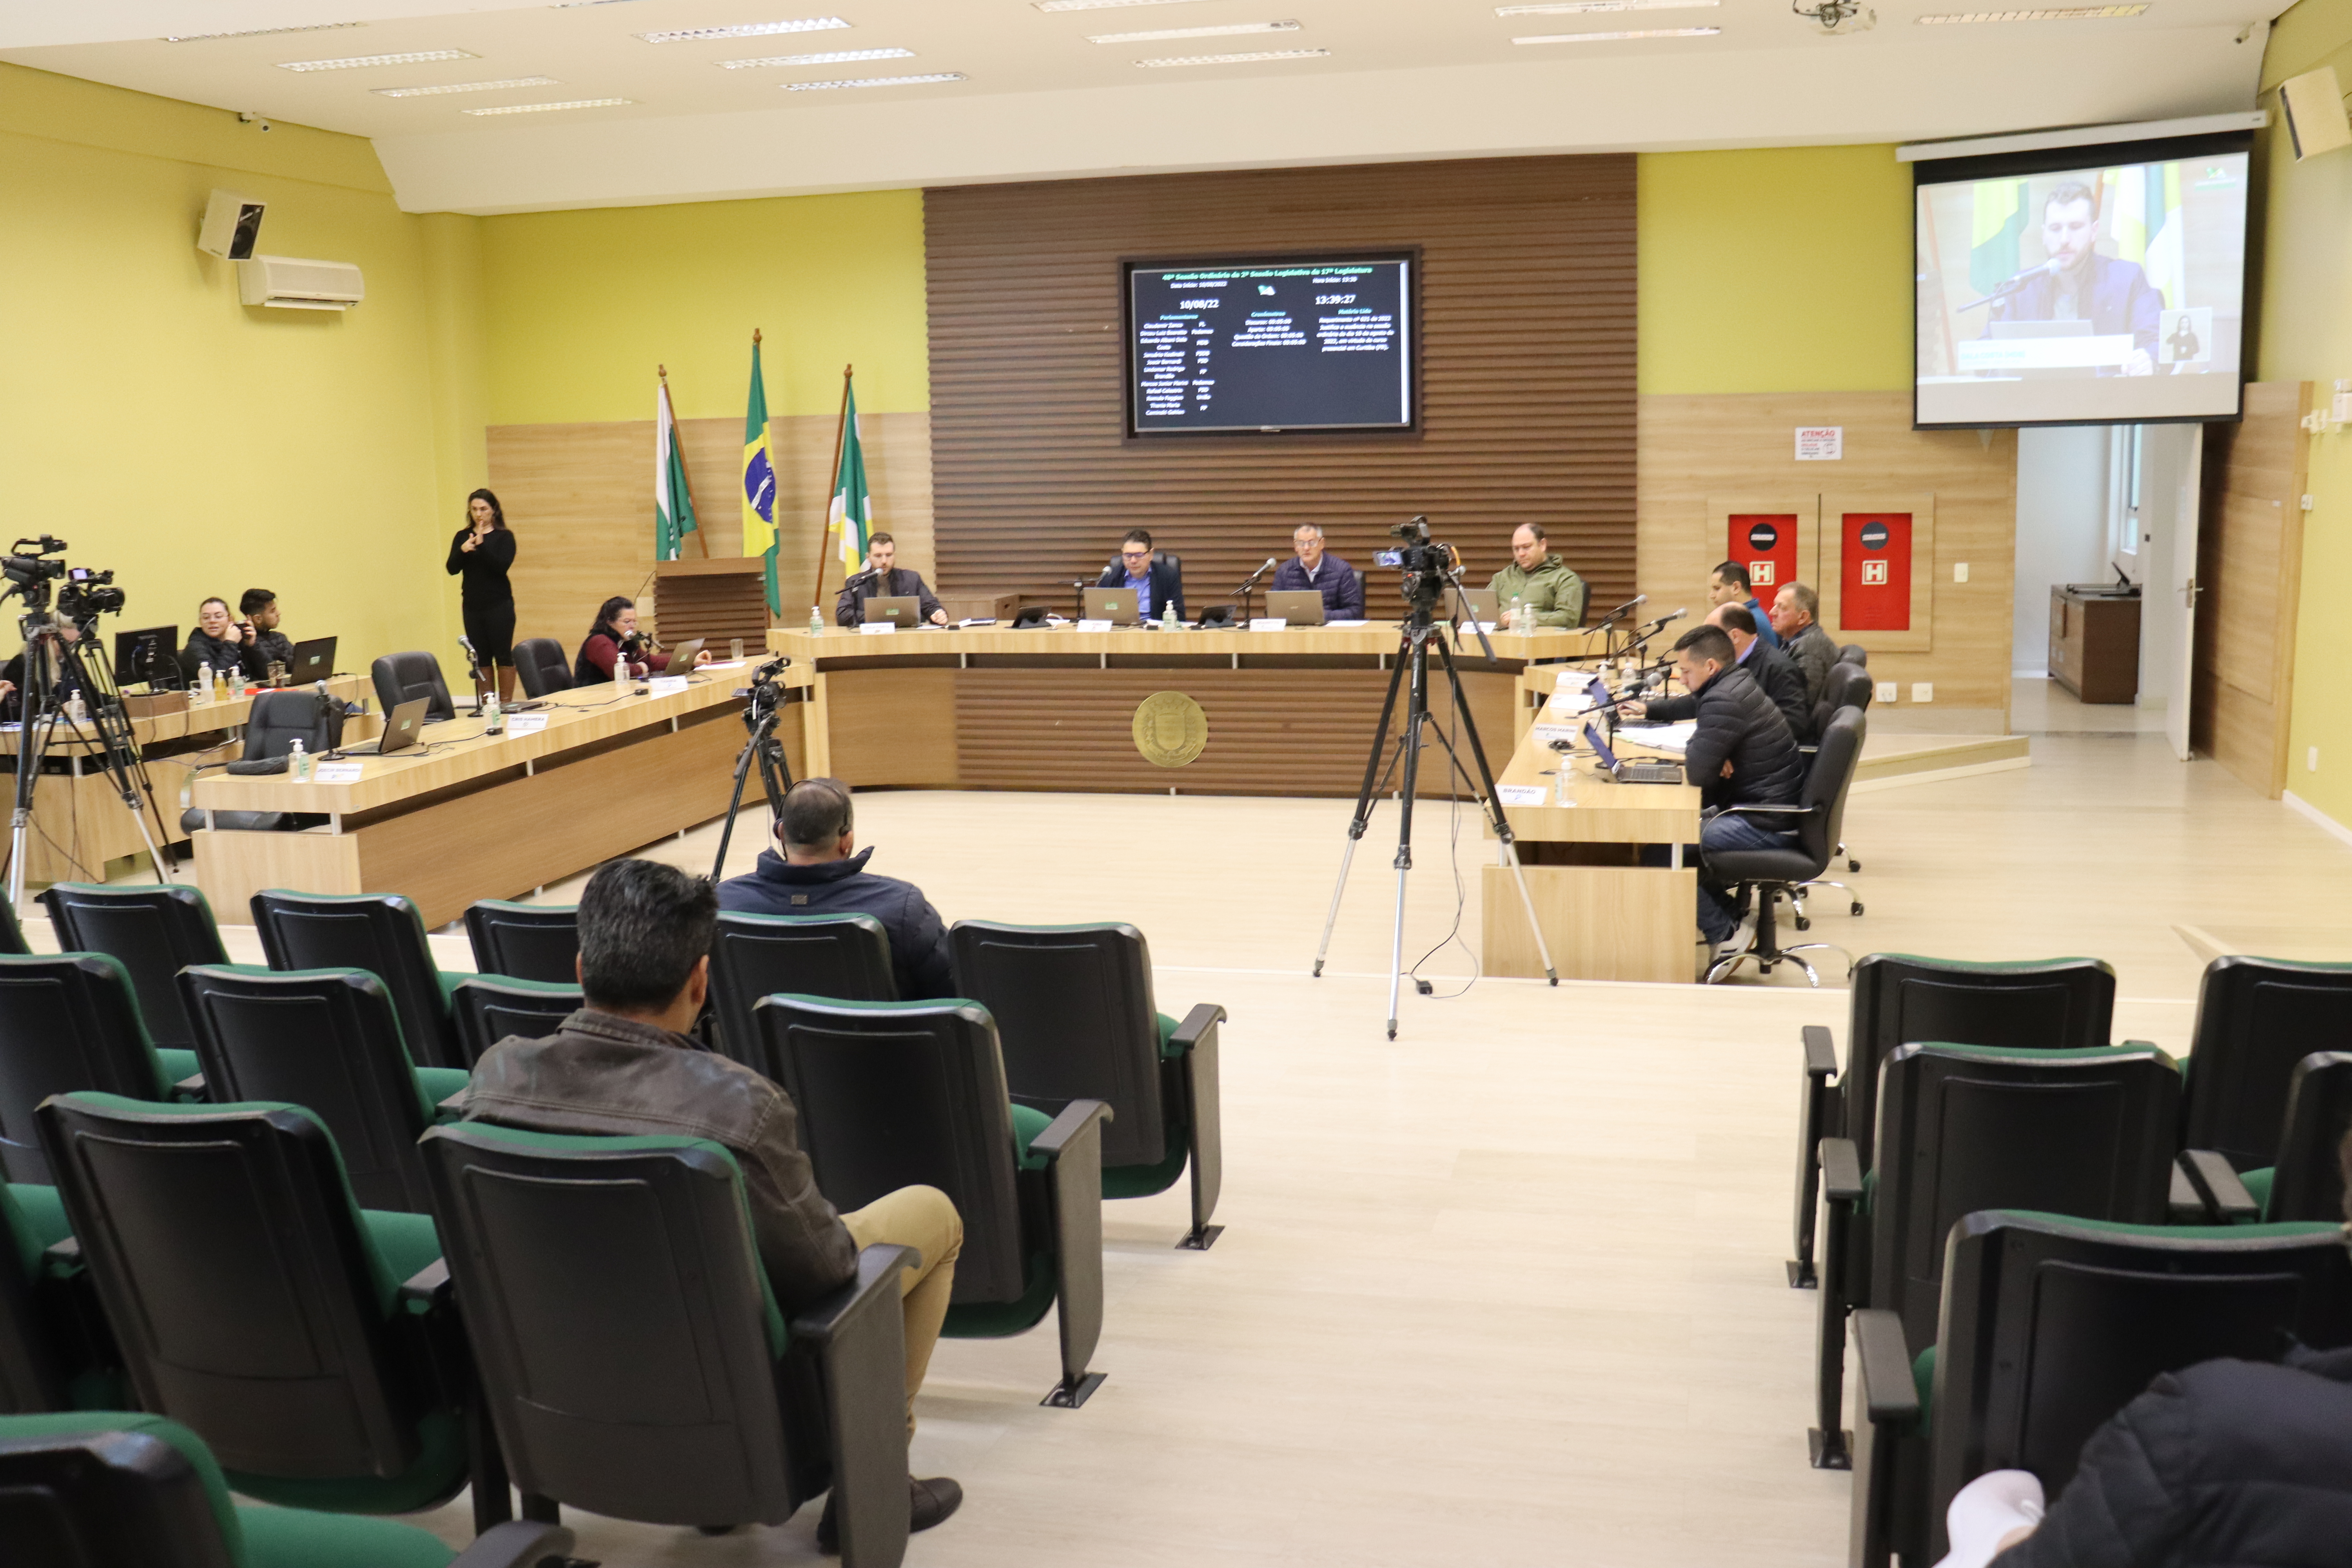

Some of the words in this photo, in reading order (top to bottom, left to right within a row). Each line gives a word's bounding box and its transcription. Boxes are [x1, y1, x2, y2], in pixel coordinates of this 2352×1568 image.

[1180, 299, 1219, 310] 10/08/22
[1315, 295, 1356, 305] 13:39:27
[1802, 429, 1835, 438] ATENÇÃO
[1753, 565, 1770, 581] H
[1866, 564, 1883, 581] H
